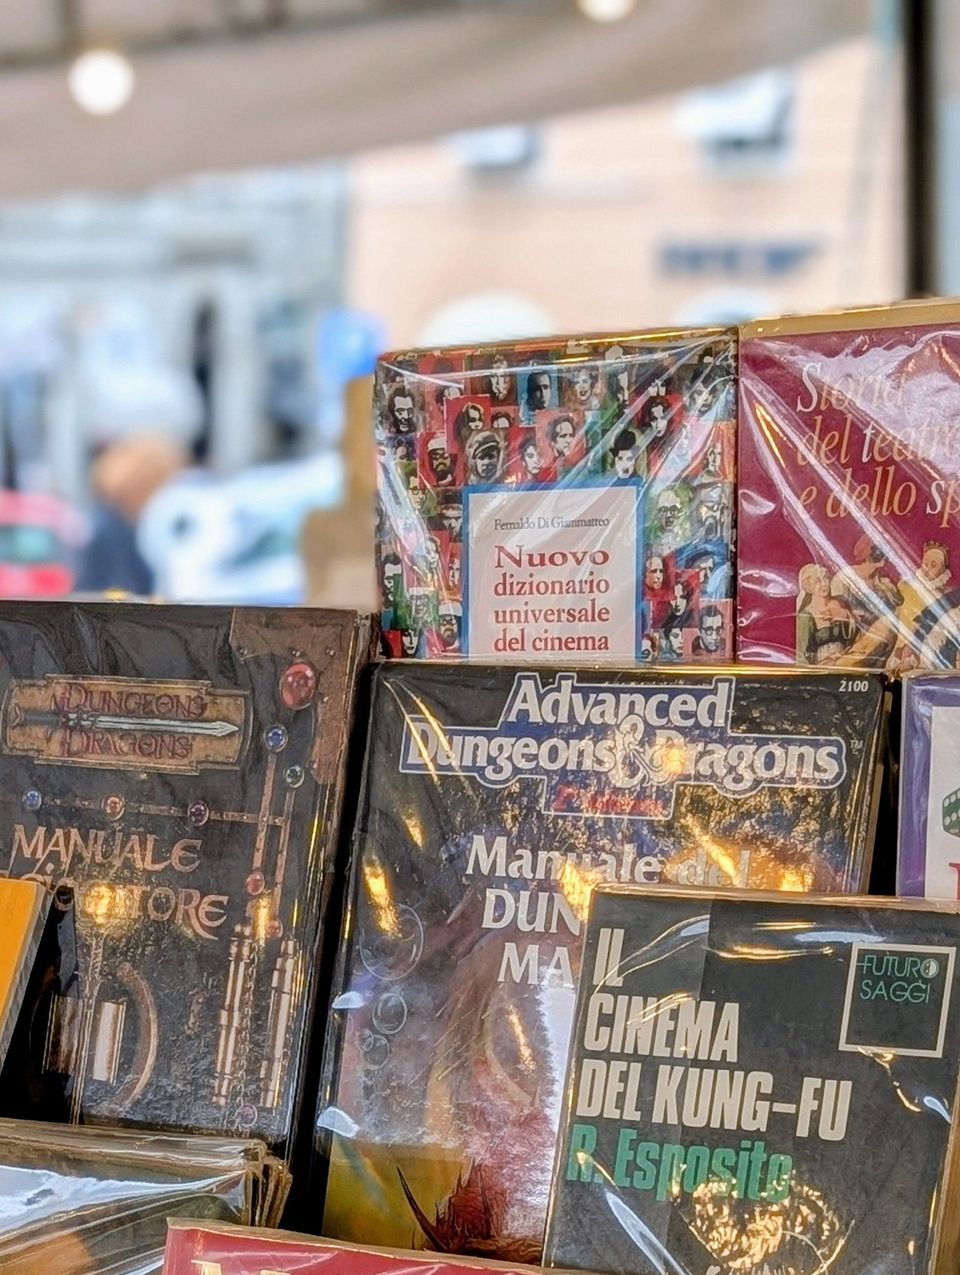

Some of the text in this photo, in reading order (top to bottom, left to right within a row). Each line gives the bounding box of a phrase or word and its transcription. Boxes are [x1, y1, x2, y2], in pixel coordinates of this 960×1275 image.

[797, 414, 852, 466] del
[800, 485, 817, 505] e
[826, 465, 917, 518] dello
[538, 517, 549, 529] Di
[494, 544, 609, 568] Nuovo
[493, 571, 610, 596] dizionario
[494, 598, 610, 623] universale
[494, 627, 609, 651] del cinema
[65, 682, 209, 719] DUNGEONS
[507, 679, 731, 728] Advanced
[839, 679, 869, 693] 2100
[63, 730, 193, 759] DRAGONS
[406, 721, 615, 782] Dungeons
[652, 729, 841, 793] Dragons
[8, 823, 203, 876] MANUALE
[465, 834, 661, 884] Manuale
[592, 928, 626, 988] IL
[860, 979, 930, 1004] SAGGI
[583, 993, 739, 1063] CINEMA
[576, 1060, 853, 1142] DEL KUNG-FU
[614, 1130, 794, 1202] Esposito
